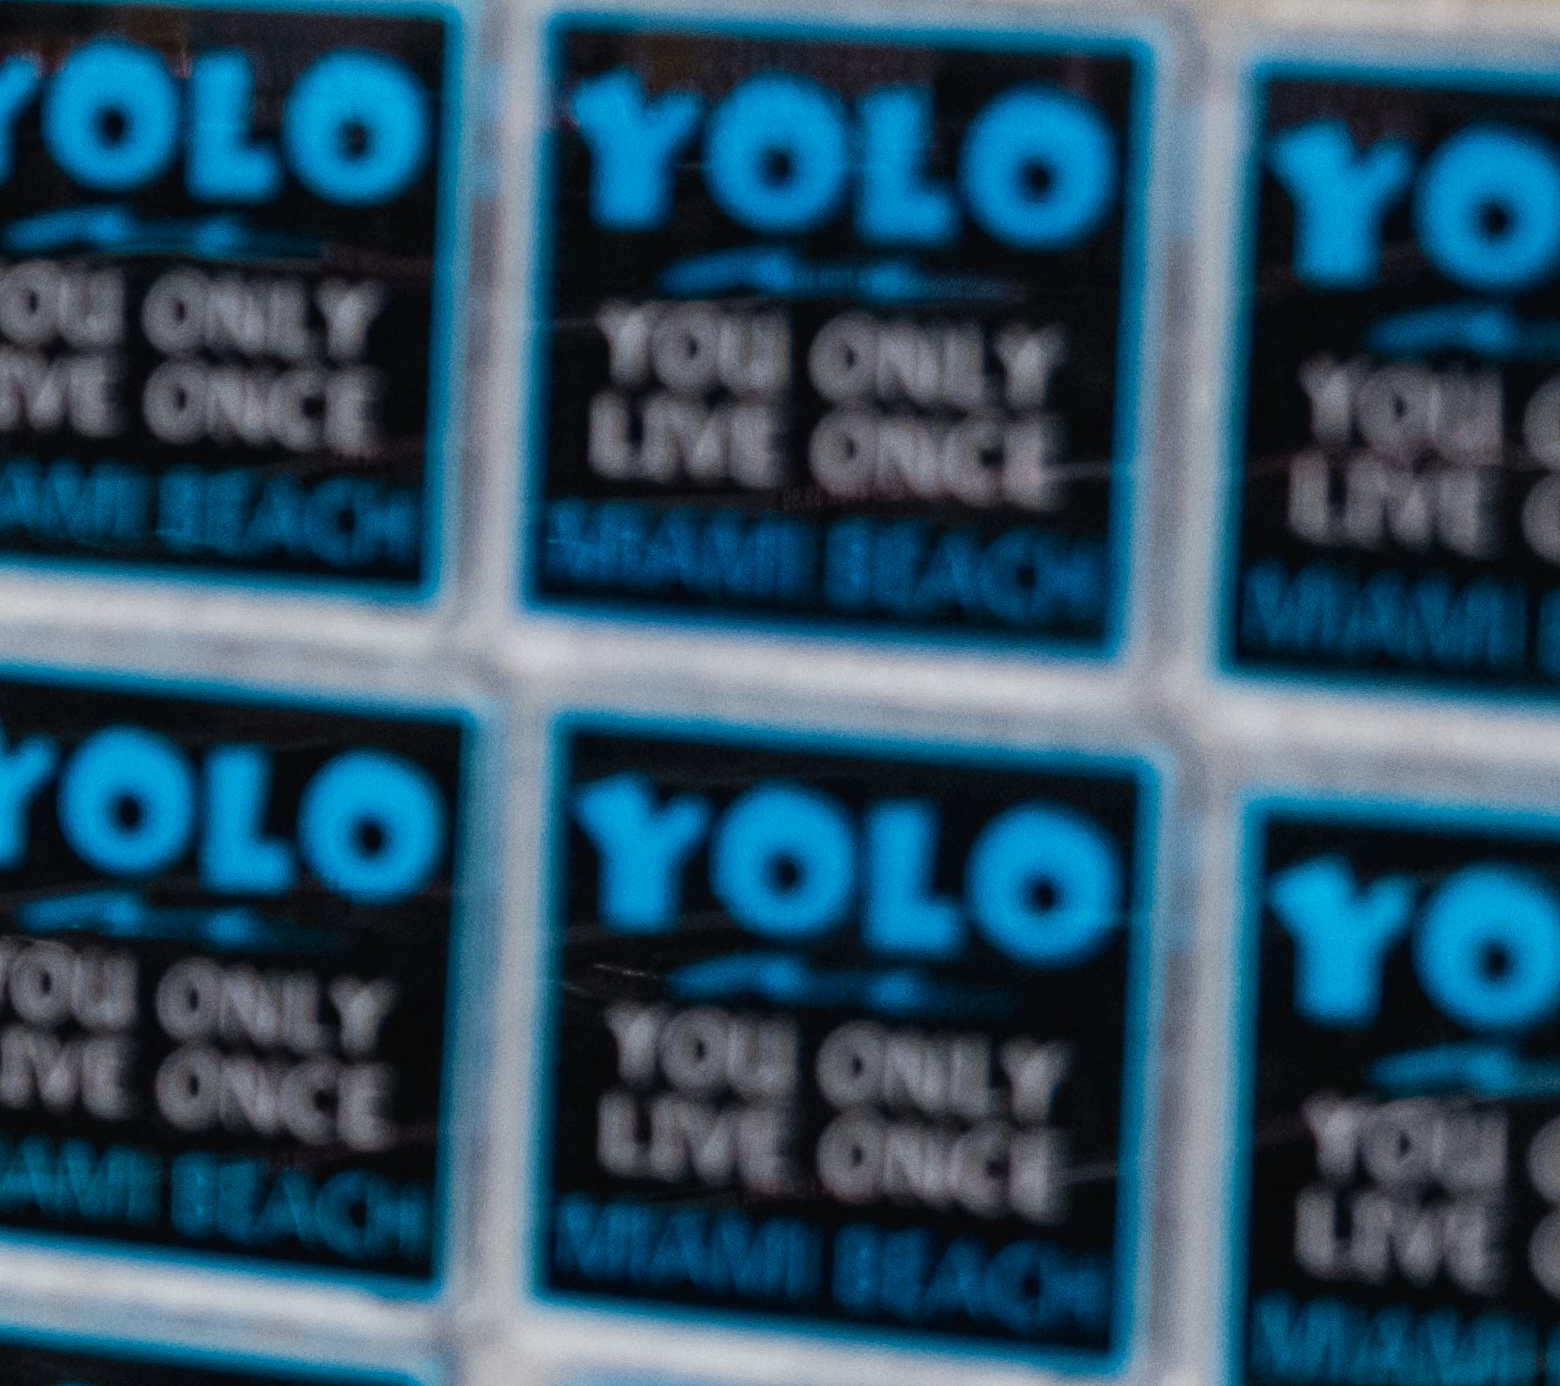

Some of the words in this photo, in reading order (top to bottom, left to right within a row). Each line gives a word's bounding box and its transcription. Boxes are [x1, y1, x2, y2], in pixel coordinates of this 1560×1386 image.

[570, 72, 1118, 248] YOLO
[144, 267, 380, 362] ONLY
[600, 302, 791, 397] YOU
[812, 315, 1063, 408] ONLY
[144, 362, 377, 457] ONCE
[589, 392, 791, 487] LIVE
[812, 411, 1060, 509] ONCE
[157, 466, 418, 562] BEACH
[549, 503, 810, 598] MIAMI
[837, 519, 1105, 617] BEACH
[574, 773, 1122, 964] YOLO
[157, 956, 396, 1051] ONLY
[157, 1045, 388, 1149] ONCE
[608, 1007, 796, 1105] YOU
[818, 1024, 1068, 1119] ONLY
[173, 1151, 425, 1260] BEACH
[600, 1094, 796, 1187] LIVE
[818, 1121, 1063, 1225] ONCE
[554, 1195, 810, 1304] MIAMI
[837, 1222, 1109, 1328] BEACH
